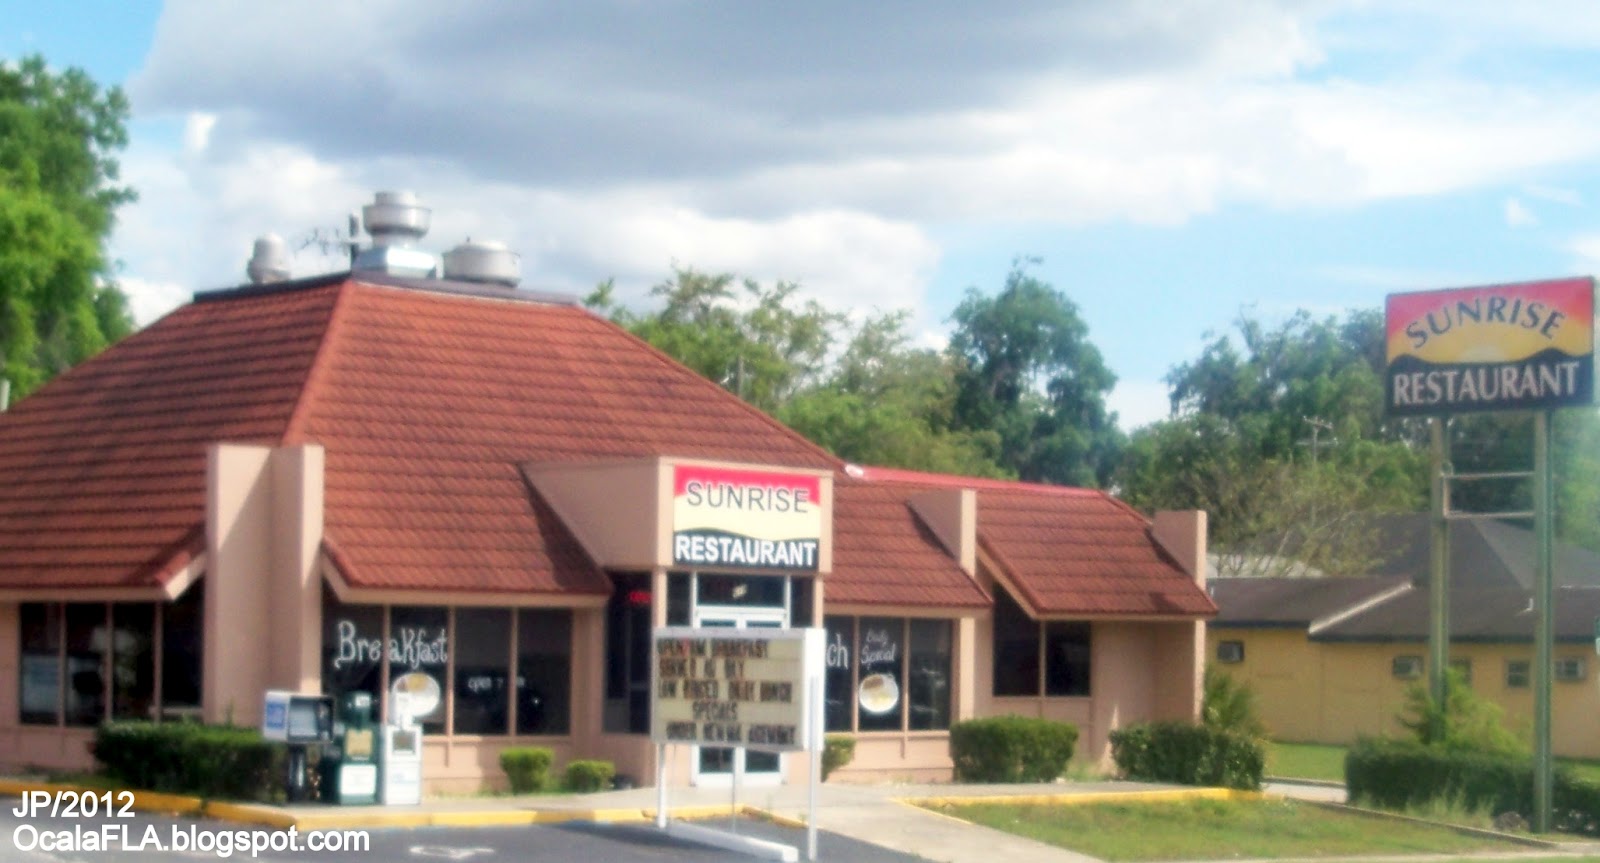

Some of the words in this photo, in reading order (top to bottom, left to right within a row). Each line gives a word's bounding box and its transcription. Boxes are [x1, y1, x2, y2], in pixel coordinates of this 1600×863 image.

[1405, 295, 1565, 349] SUNRISE
[1393, 361, 1579, 407] RESTAURANT
[686, 482, 808, 513] SUNRISE
[675, 535, 816, 566] RESTAURANT
